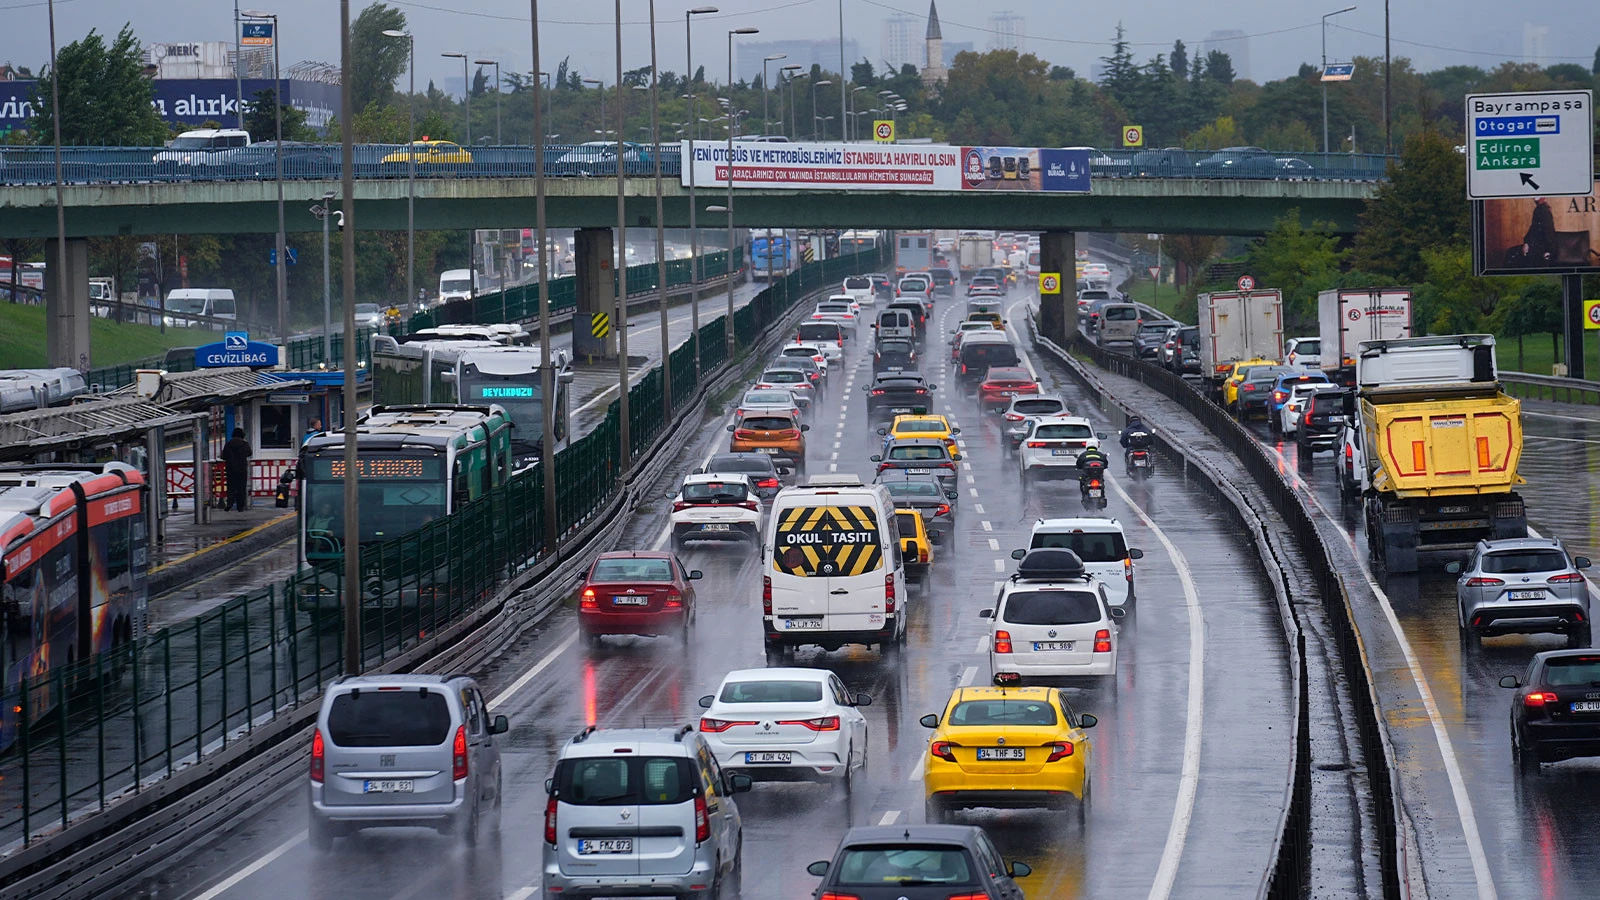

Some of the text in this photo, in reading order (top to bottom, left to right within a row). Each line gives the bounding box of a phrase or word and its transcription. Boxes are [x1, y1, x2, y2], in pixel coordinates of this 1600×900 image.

[168, 44, 199, 57] MERİÇ
[175, 94, 261, 115] alırke
[1474, 100, 1583, 115] Bayrampaşa
[1478, 119, 1533, 133] Otogar
[1479, 142, 1532, 154] Edirne
[692, 145, 712, 162] YENİ
[713, 146, 748, 162] OTOBÜS
[750, 150, 761, 162] VE
[763, 147, 842, 165] METROBÜSLERİMİZ
[894, 152, 927, 166] HAYIRLI
[928, 153, 956, 167] OLSUN
[1480, 155, 1537, 167] Ankara
[717, 169, 732, 178] YEN
[733, 170, 774, 180] ARAÇLARIMIZI
[776, 170, 787, 180] ÇOK
[789, 170, 813, 179] YAKINDA
[869, 170, 899, 181] HİZMETİNE
[900, 171, 932, 182] SUNACAĞIZ
[1567, 196, 1600, 213] AR
[207, 351, 267, 364] CEVİZLİBAĞ
[482, 387, 533, 397] BEYLIKDUZU
[787, 532, 872, 545] OKUL TAŞITI
[750, 753, 757, 761] 61
[777, 753, 790, 761] 424
[981, 749, 1023, 758] 34 THF 95
[368, 781, 378, 790] 34
[584, 840, 631, 850] 34 FMZ 873
